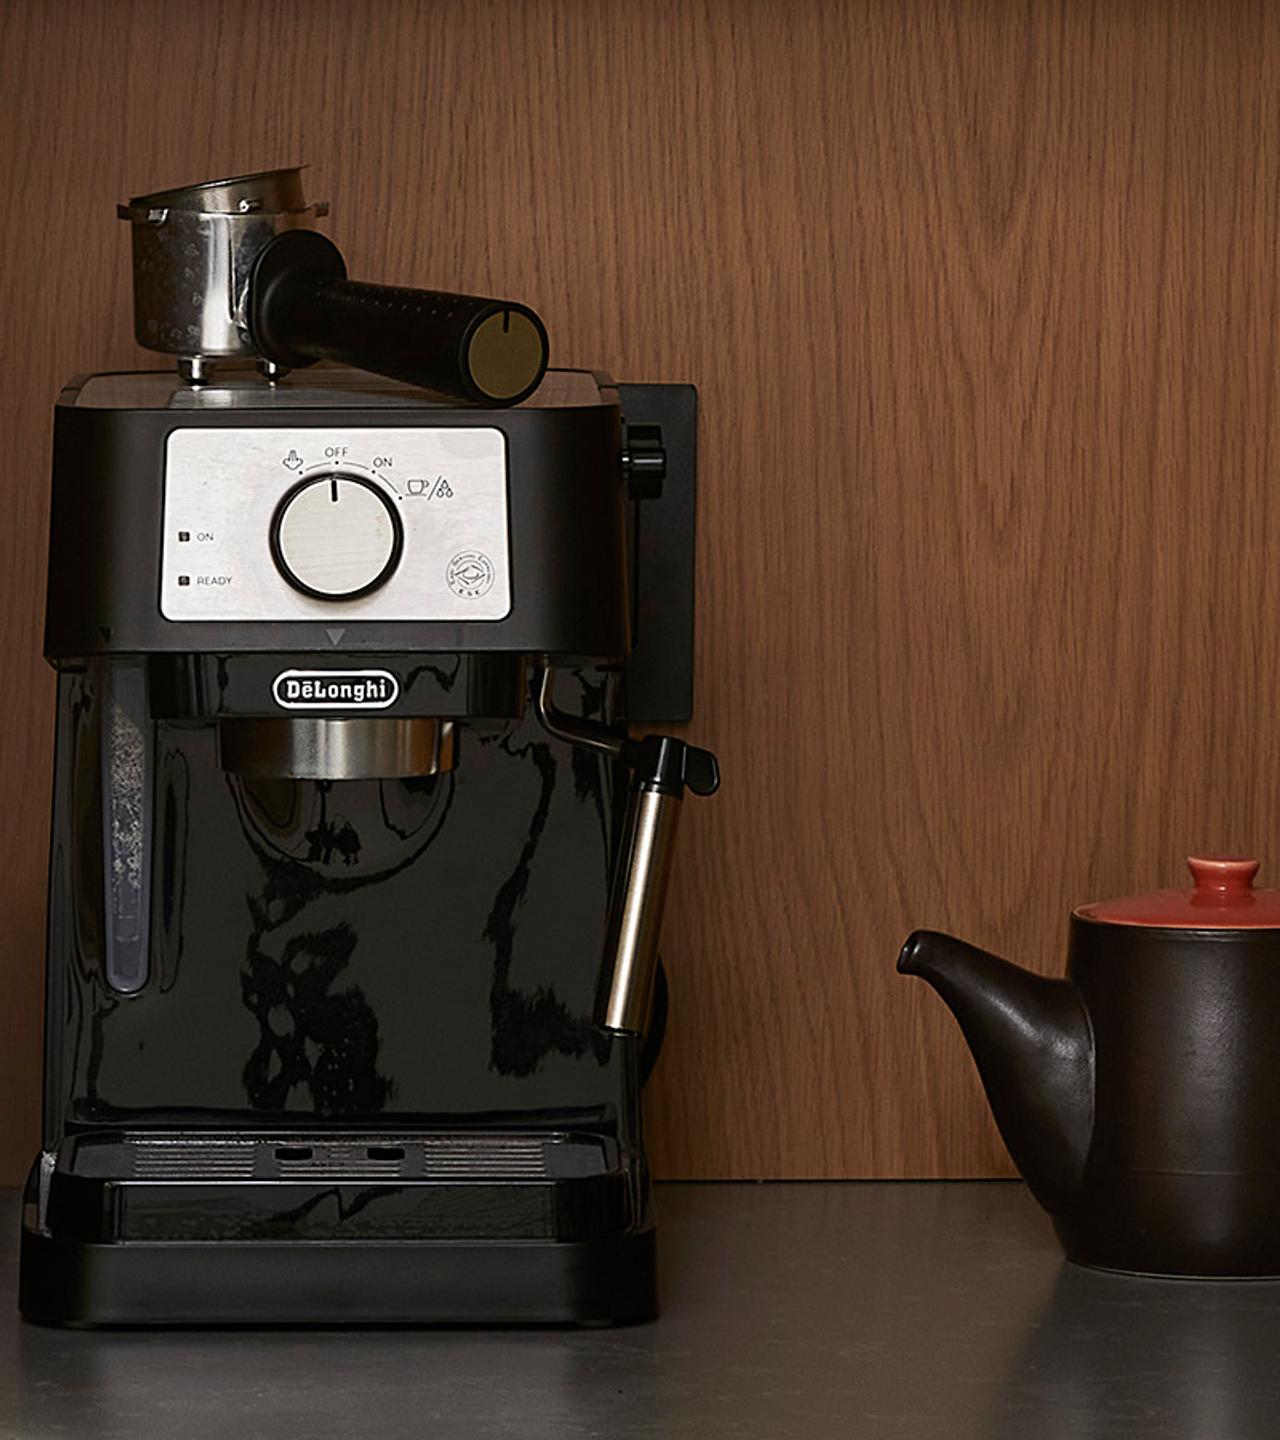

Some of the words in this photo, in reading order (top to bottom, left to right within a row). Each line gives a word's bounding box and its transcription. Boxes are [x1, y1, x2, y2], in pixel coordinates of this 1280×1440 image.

[324, 446, 349, 458] OFF
[372, 456, 393, 468] ON
[196, 532, 214, 542] ON
[196, 575, 233, 586] READY
